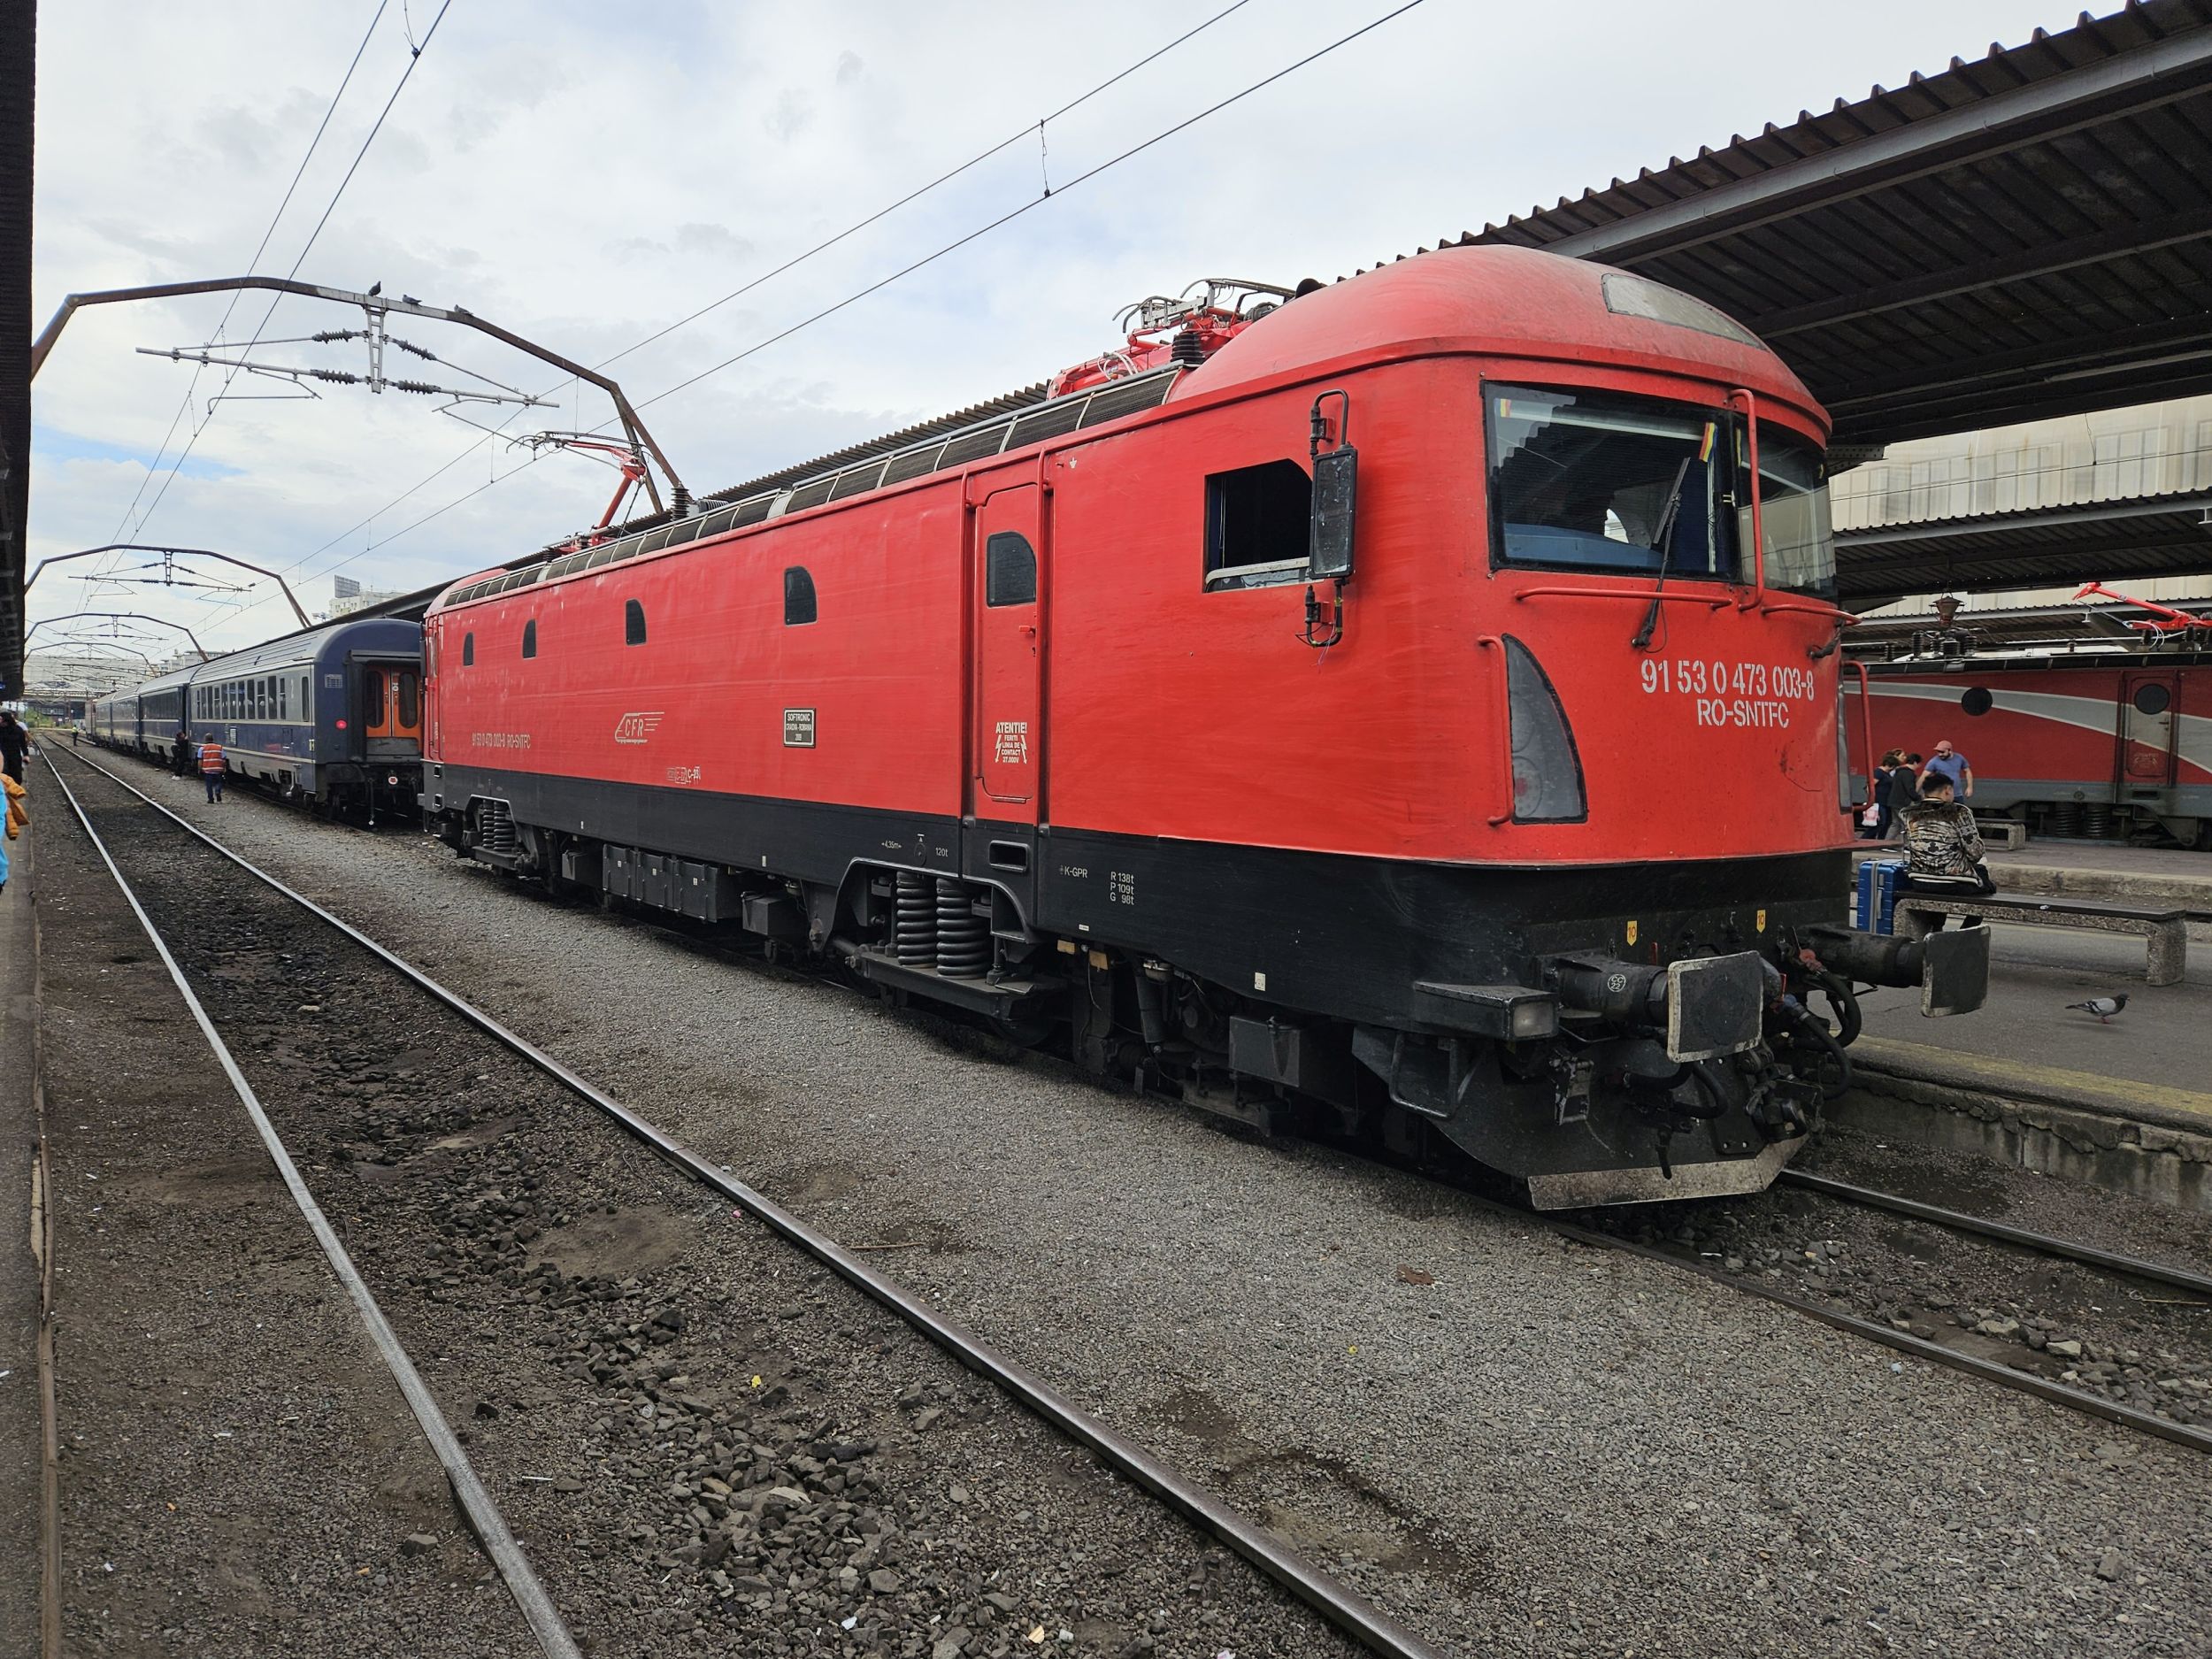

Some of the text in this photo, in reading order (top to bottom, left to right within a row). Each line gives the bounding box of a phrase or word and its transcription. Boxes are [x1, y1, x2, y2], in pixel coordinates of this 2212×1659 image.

[1640, 658, 1815, 702] 91 53 0 473 003-8
[787, 713, 810, 722] SOFTRONIC
[1696, 698, 1790, 729] RO-SNTFC
[625, 718, 644, 737] CFR
[995, 721, 1027, 734] ATENTIE!
[935, 847, 949, 857] 120t
[1064, 866, 1088, 879] K-GPR
[1110, 871, 1134, 885] R 138t
[1110, 881, 1134, 895] P 109t
[1110, 891, 1134, 905] G 98t
[1758, 914, 1765, 926] 10
[1628, 926, 1637, 939] 10
